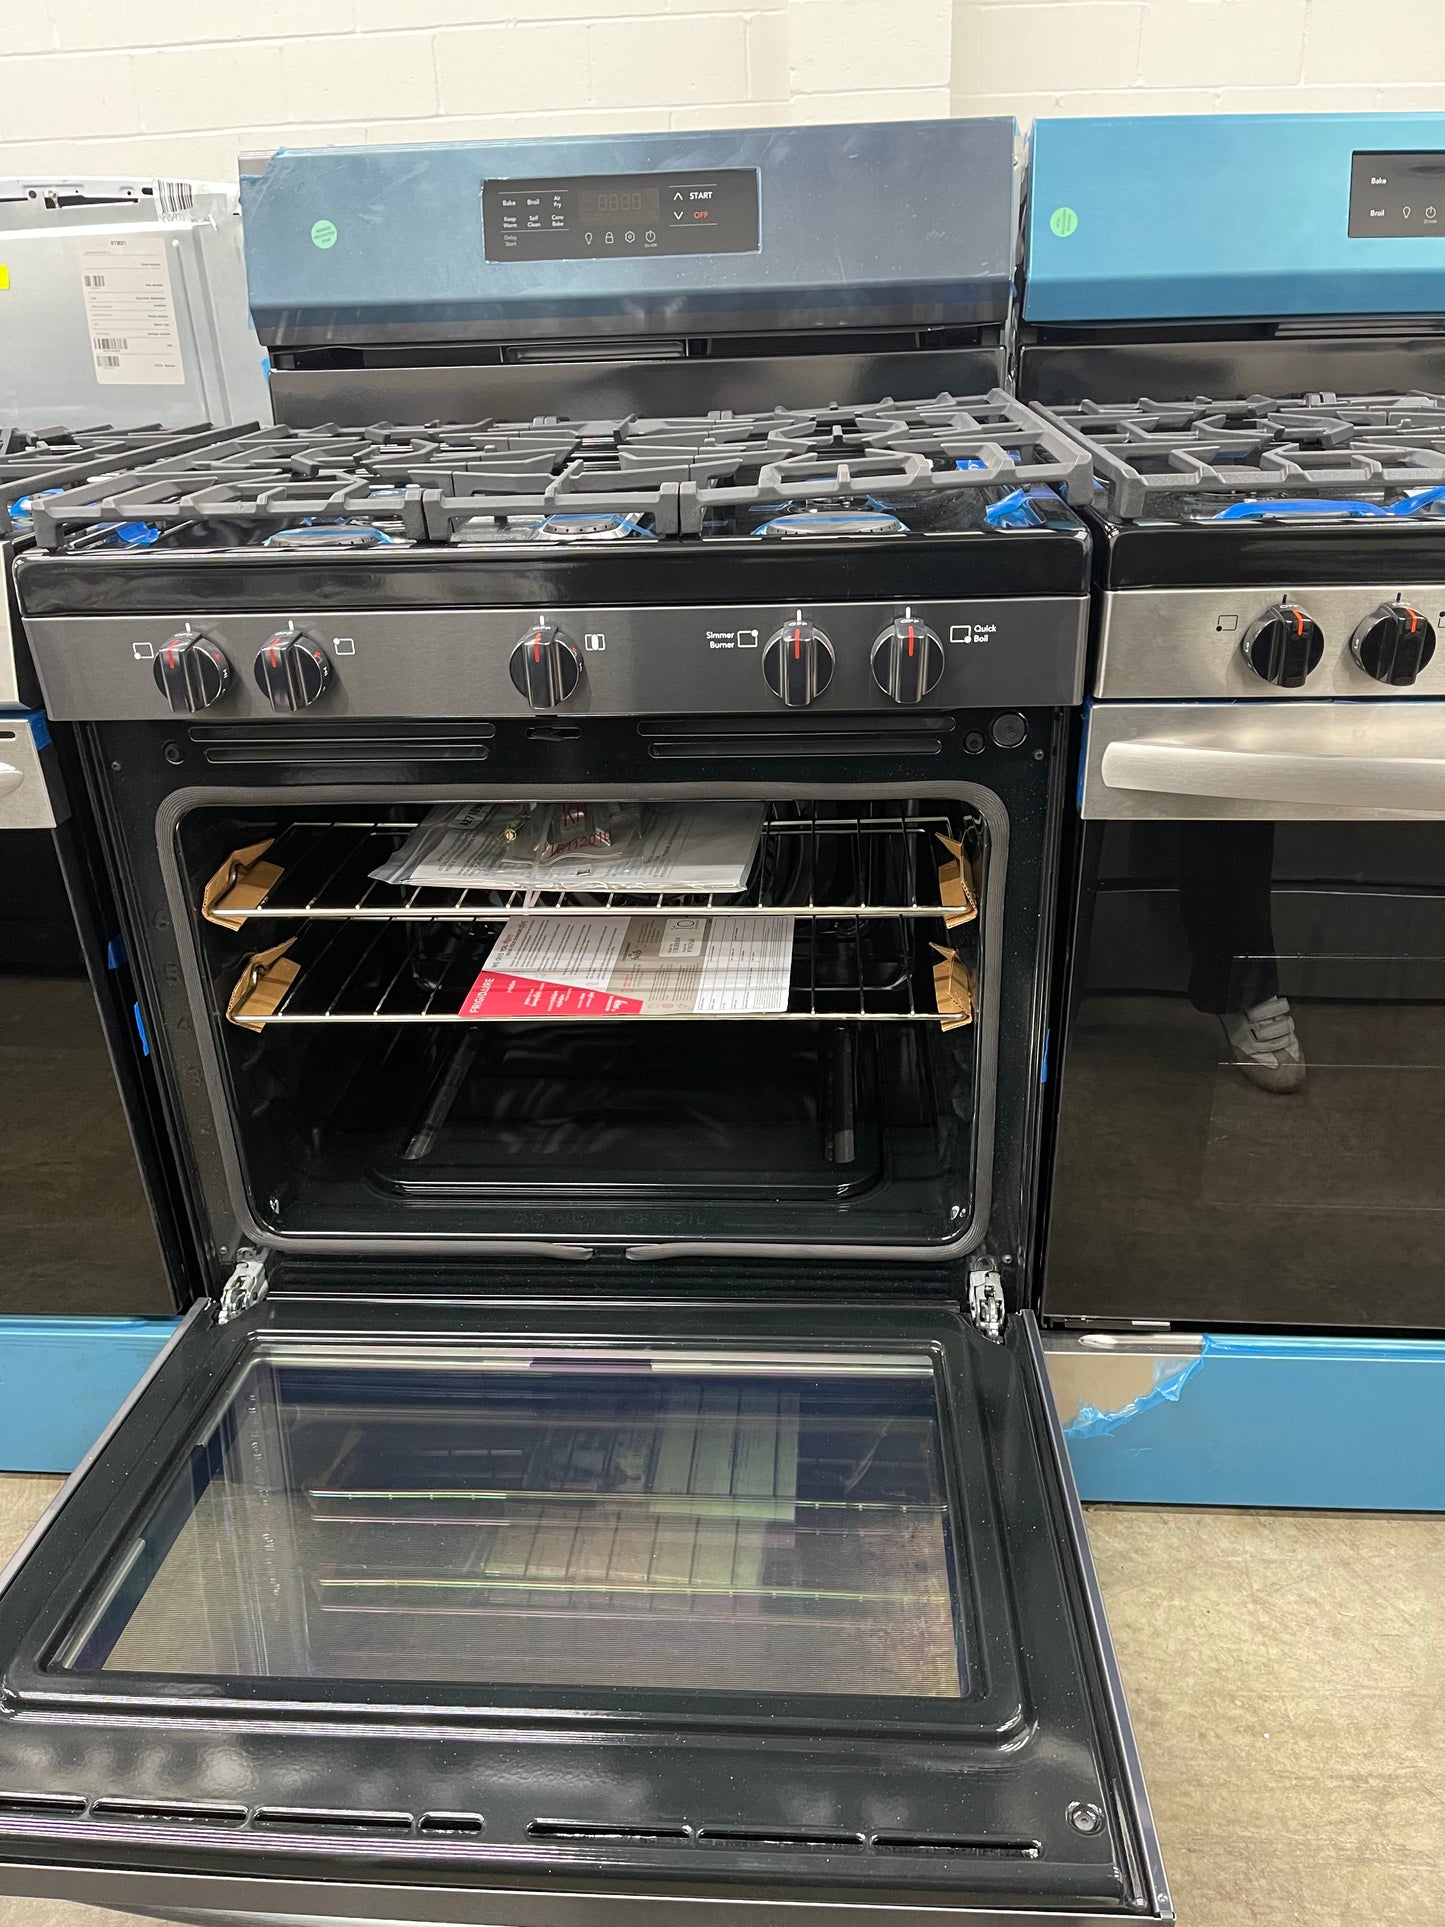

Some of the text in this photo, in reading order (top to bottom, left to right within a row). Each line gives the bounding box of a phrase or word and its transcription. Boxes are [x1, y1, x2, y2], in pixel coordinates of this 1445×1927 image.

[1370, 177, 1387, 185] Bake
[689, 191, 713, 200] START
[502, 199, 516, 207] Bake
[526, 198, 540, 206] Broil
[693, 211, 709, 219] OFF
[1369, 209, 1385, 217] Broil
[973, 624, 997, 633] Quick
[705, 631, 735, 640] Simmer
[973, 634, 989, 643] Boil
[709, 641, 735, 649] Burner
[469, 977, 495, 1014] FRIGIDAIRE
